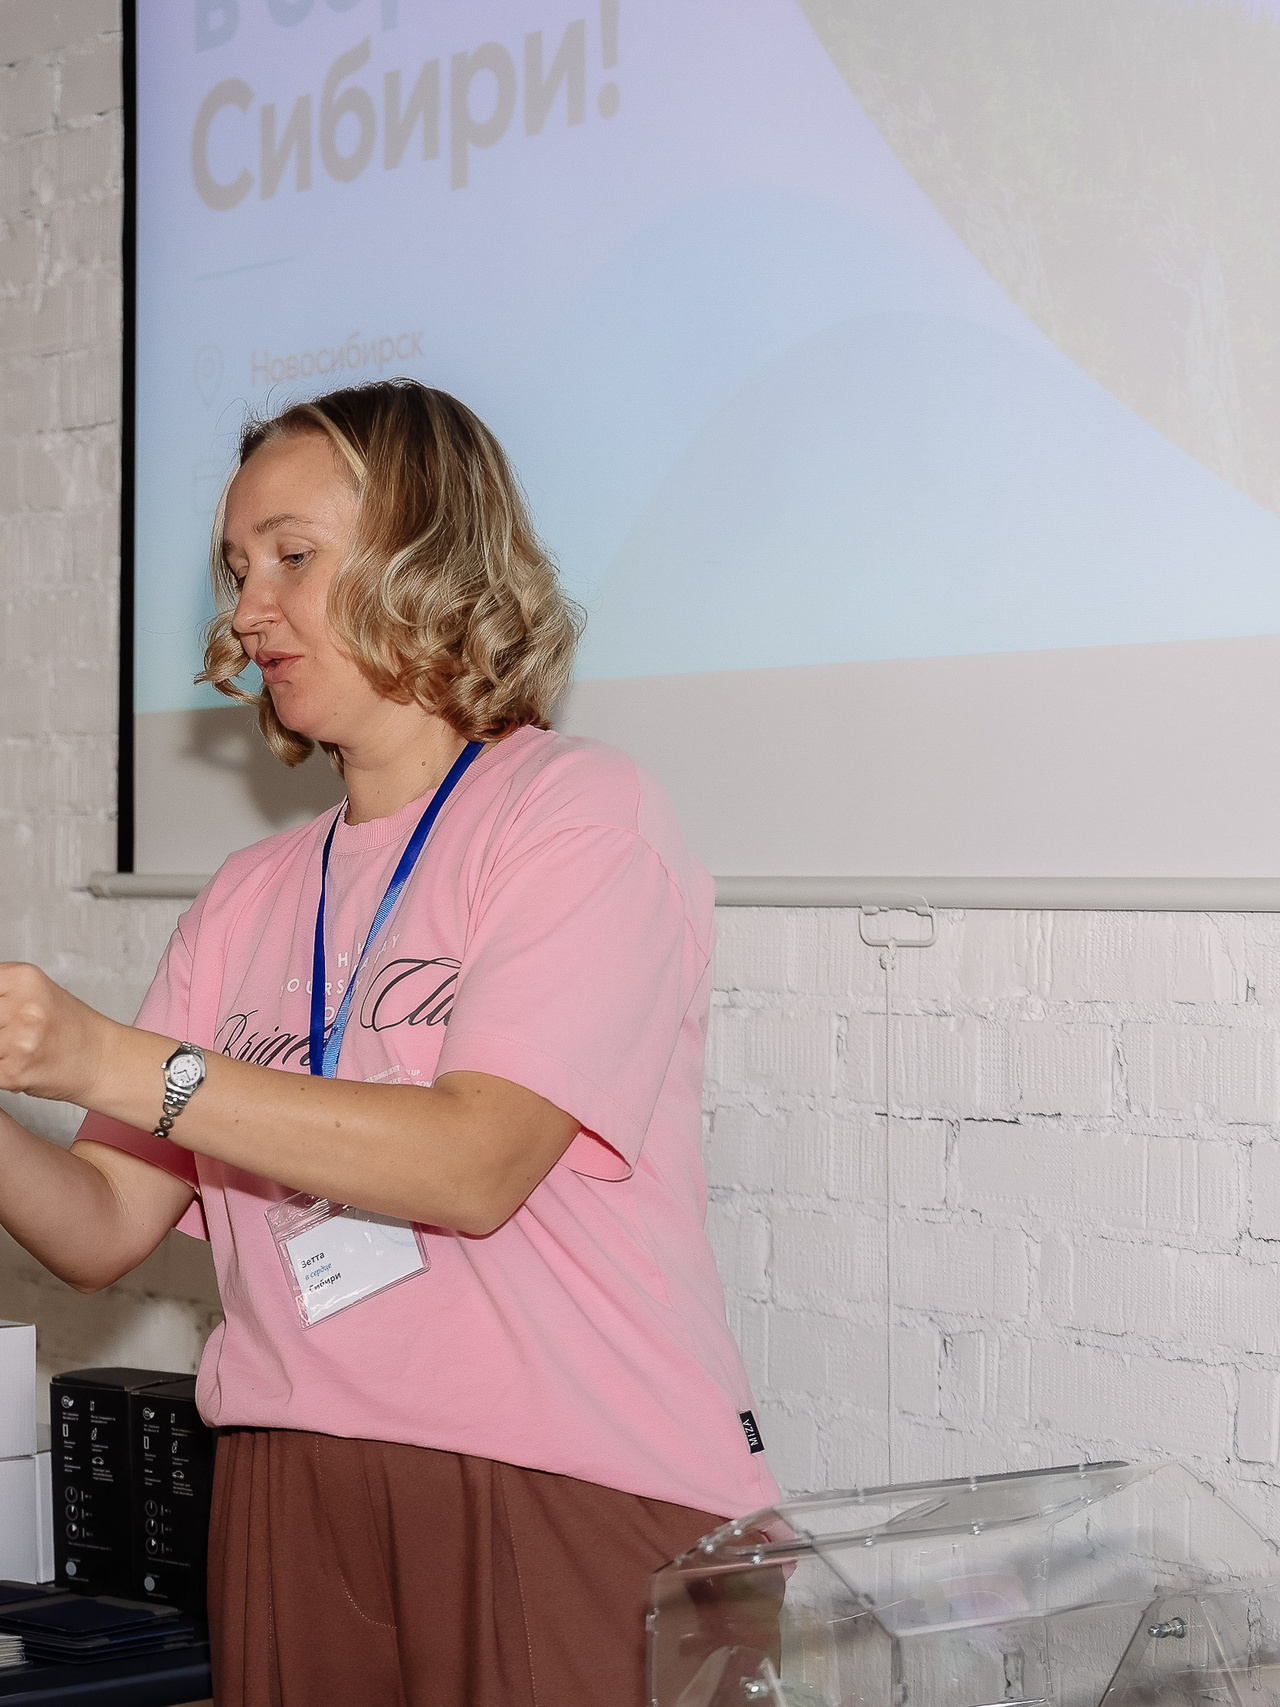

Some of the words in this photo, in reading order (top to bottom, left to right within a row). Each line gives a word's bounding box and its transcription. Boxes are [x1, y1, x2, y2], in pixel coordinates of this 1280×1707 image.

[190, 0, 621, 212] Сибири!
[249, 330, 425, 387] Новосибирск
[301, 1252, 325, 1269] Зетта
[742, 1418, 759, 1447] MIZA
